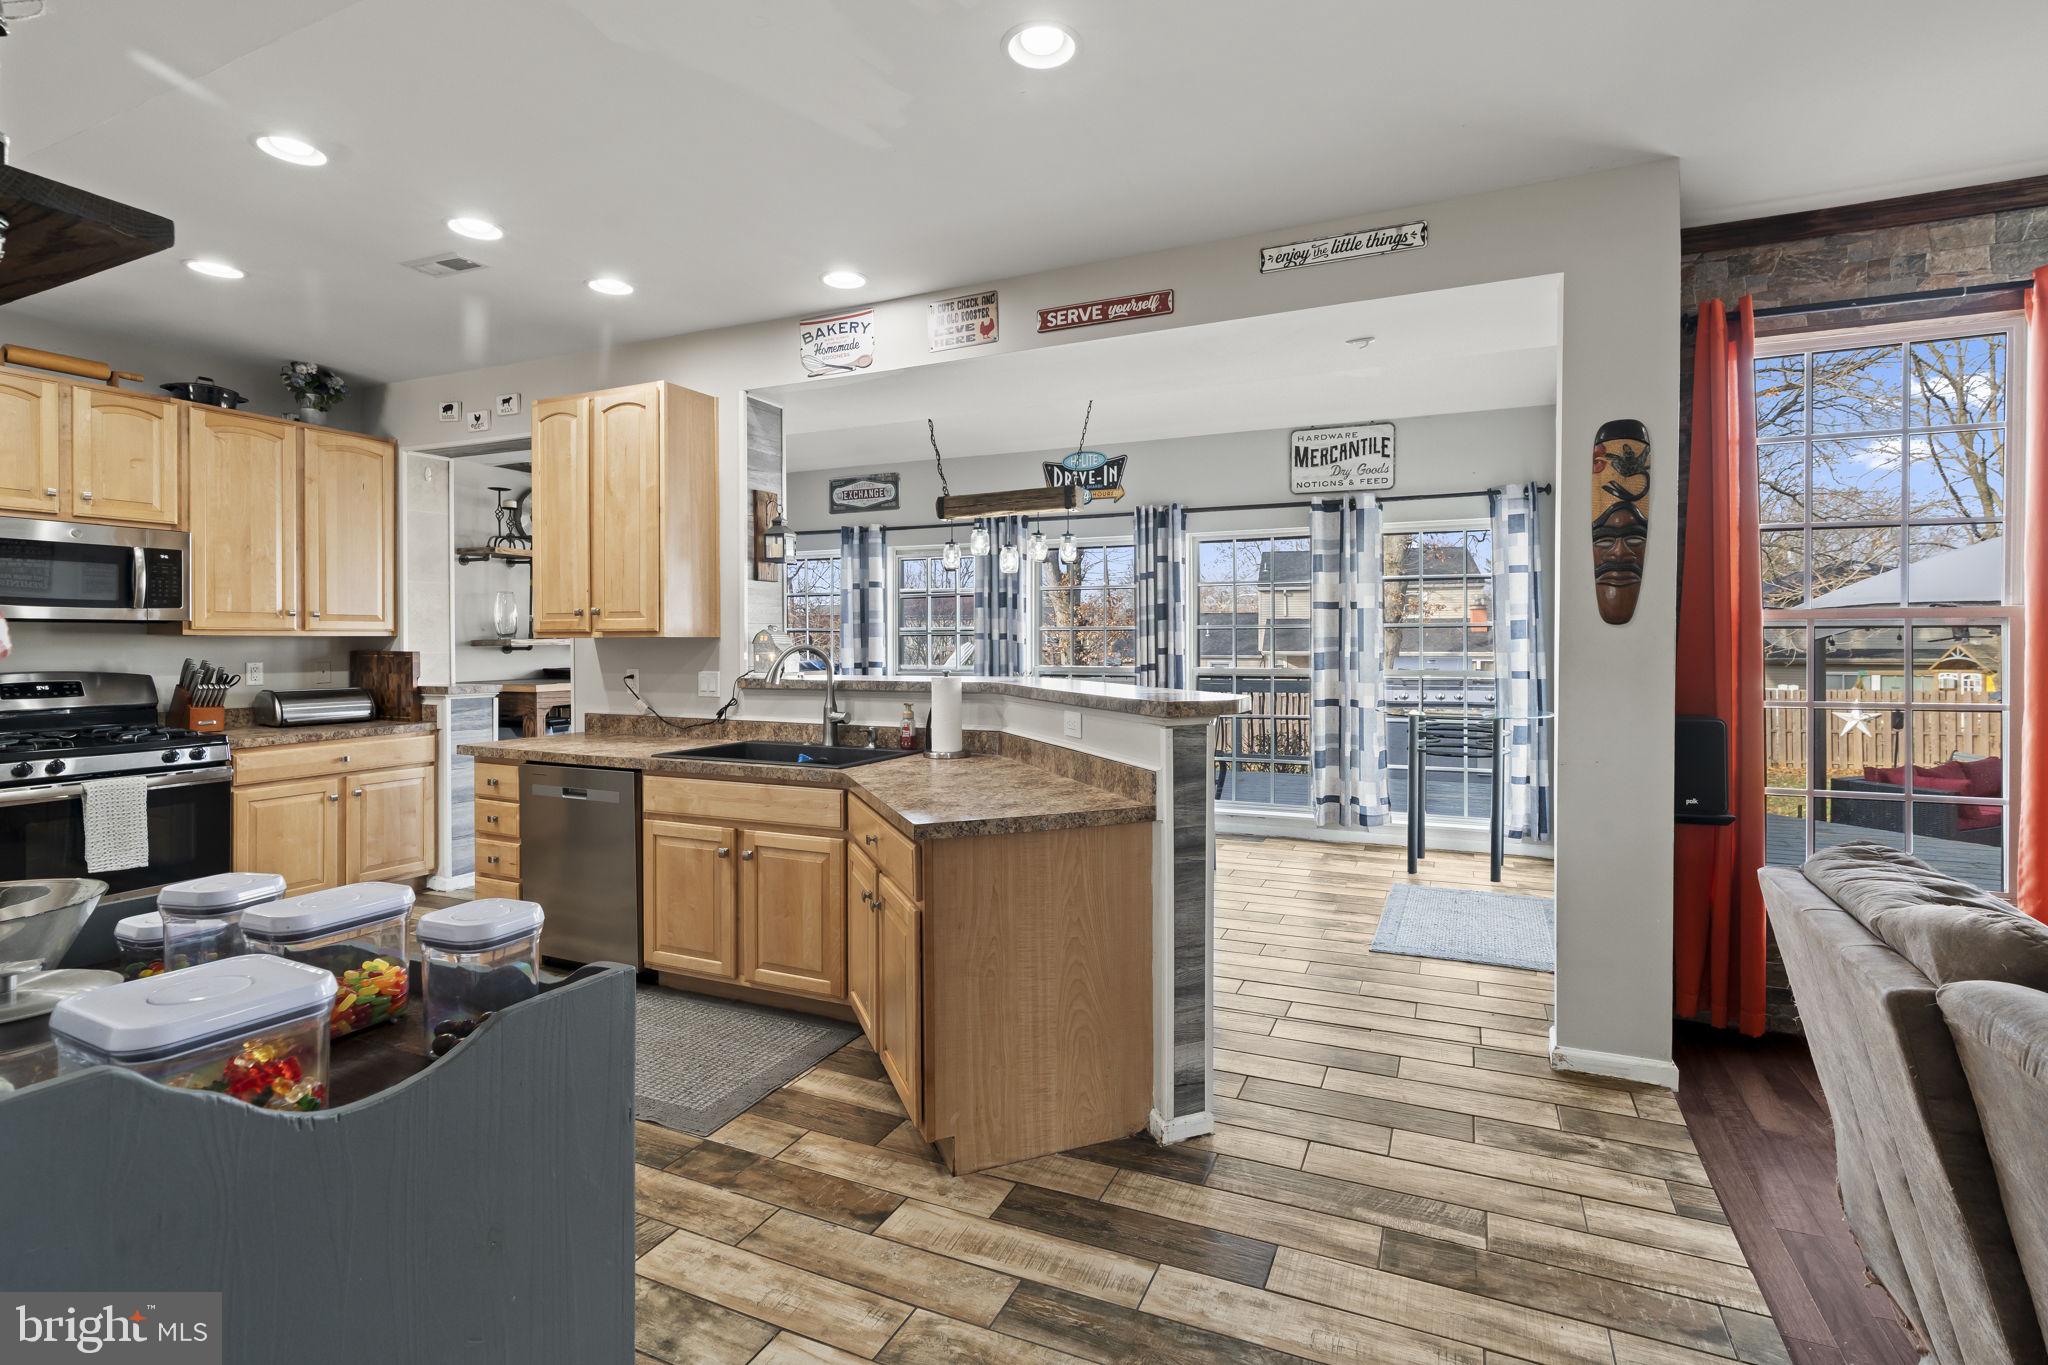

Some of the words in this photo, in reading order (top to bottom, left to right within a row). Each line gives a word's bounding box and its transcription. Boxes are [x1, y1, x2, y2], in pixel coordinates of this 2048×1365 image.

[1275, 248, 1311, 268] enjoy
[1312, 244, 1329, 259] the
[1331, 235, 1363, 254] little
[1366, 232, 1413, 251] things
[956, 297, 979, 310] CHICK
[981, 292, 996, 306] AND
[961, 307, 990, 321] ROOSTER
[1046, 305, 1103, 327] SERVE
[1107, 294, 1161, 320] yourself
[801, 321, 872, 345] BAKERY
[813, 338, 861, 356] Homemade
[1297, 431, 1359, 443] HARDWARE
[1294, 436, 1391, 468] MERCANTILE
[1329, 464, 1353, 481] Dry
[1356, 462, 1390, 476] Goods
[1296, 479, 1345, 489] NOTIONS
[1359, 477, 1389, 486] FEED
[843, 488, 884, 500] EXCHANGE
[1685, 798, 1699, 806] polk
